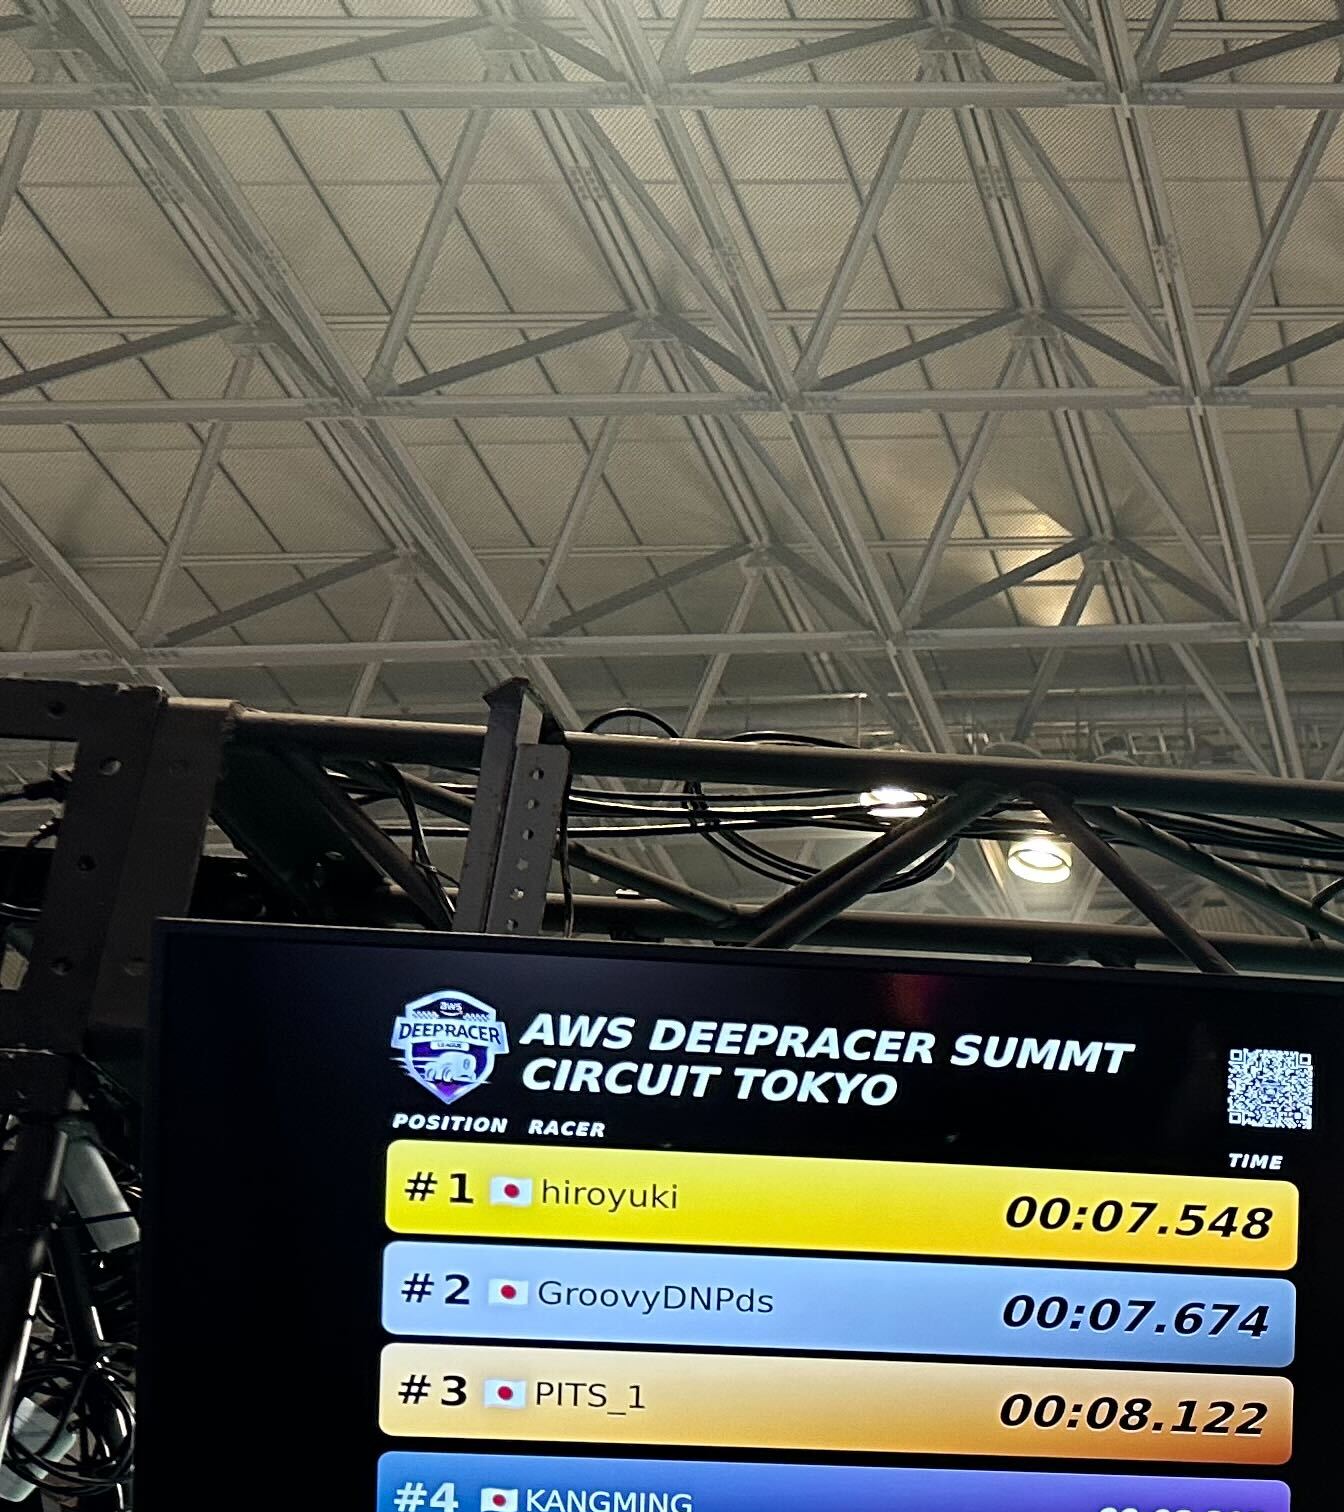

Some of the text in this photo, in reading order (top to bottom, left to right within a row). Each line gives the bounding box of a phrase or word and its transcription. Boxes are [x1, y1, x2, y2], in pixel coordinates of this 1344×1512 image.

[399, 1022, 502, 1045] DEEPRACER
[519, 1012, 1137, 1076] AWS DEEPRACER SUMMT
[521, 1057, 900, 1108] CIRCUIT TOKYO
[391, 1113, 606, 1138] POSITION RACER
[1228, 1152, 1284, 1171] TIME
[541, 1178, 679, 1213] hiroyuki
[1005, 1195, 1274, 1240] 00:07.548
[537, 1279, 775, 1315] GroovyDNPds
[1002, 1293, 1270, 1338] 00:07.674
[535, 1381, 647, 1416] PITS_1
[999, 1392, 1269, 1436] 00:08.122
